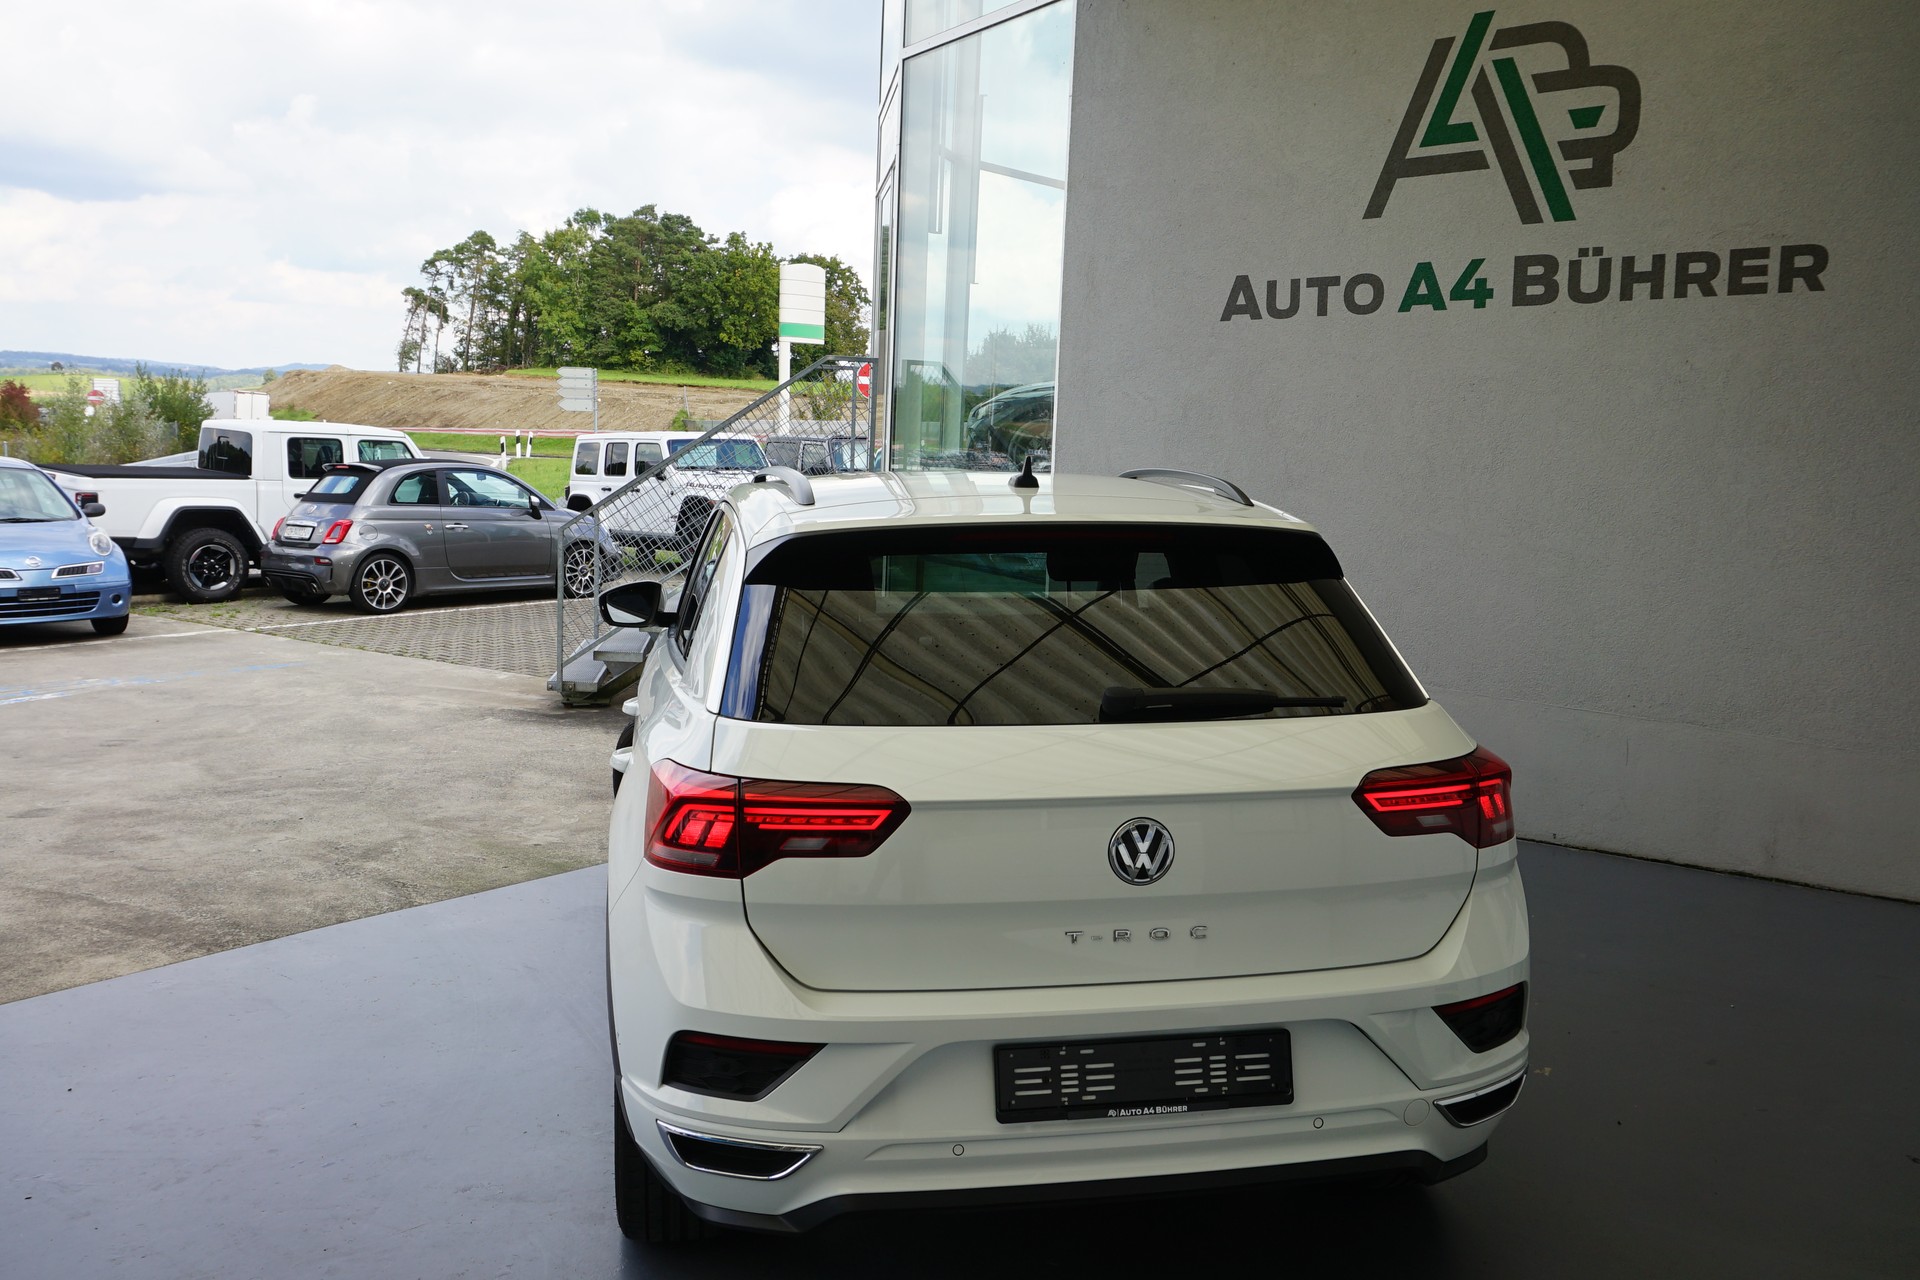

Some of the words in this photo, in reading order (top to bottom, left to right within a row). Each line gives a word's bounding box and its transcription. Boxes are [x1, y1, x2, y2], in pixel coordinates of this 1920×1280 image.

[1220, 272, 1385, 322] AUTO
[1398, 258, 1494, 312] A4
[1512, 243, 1830, 307] BÜHRER
[1110, 818, 1174, 884] VW
[1064, 925, 1208, 944] T-ROC
[1120, 1108, 1141, 1116] AUTO
[1143, 1107, 1154, 1115] A4
[1155, 1105, 1188, 1114] BÜHRER
